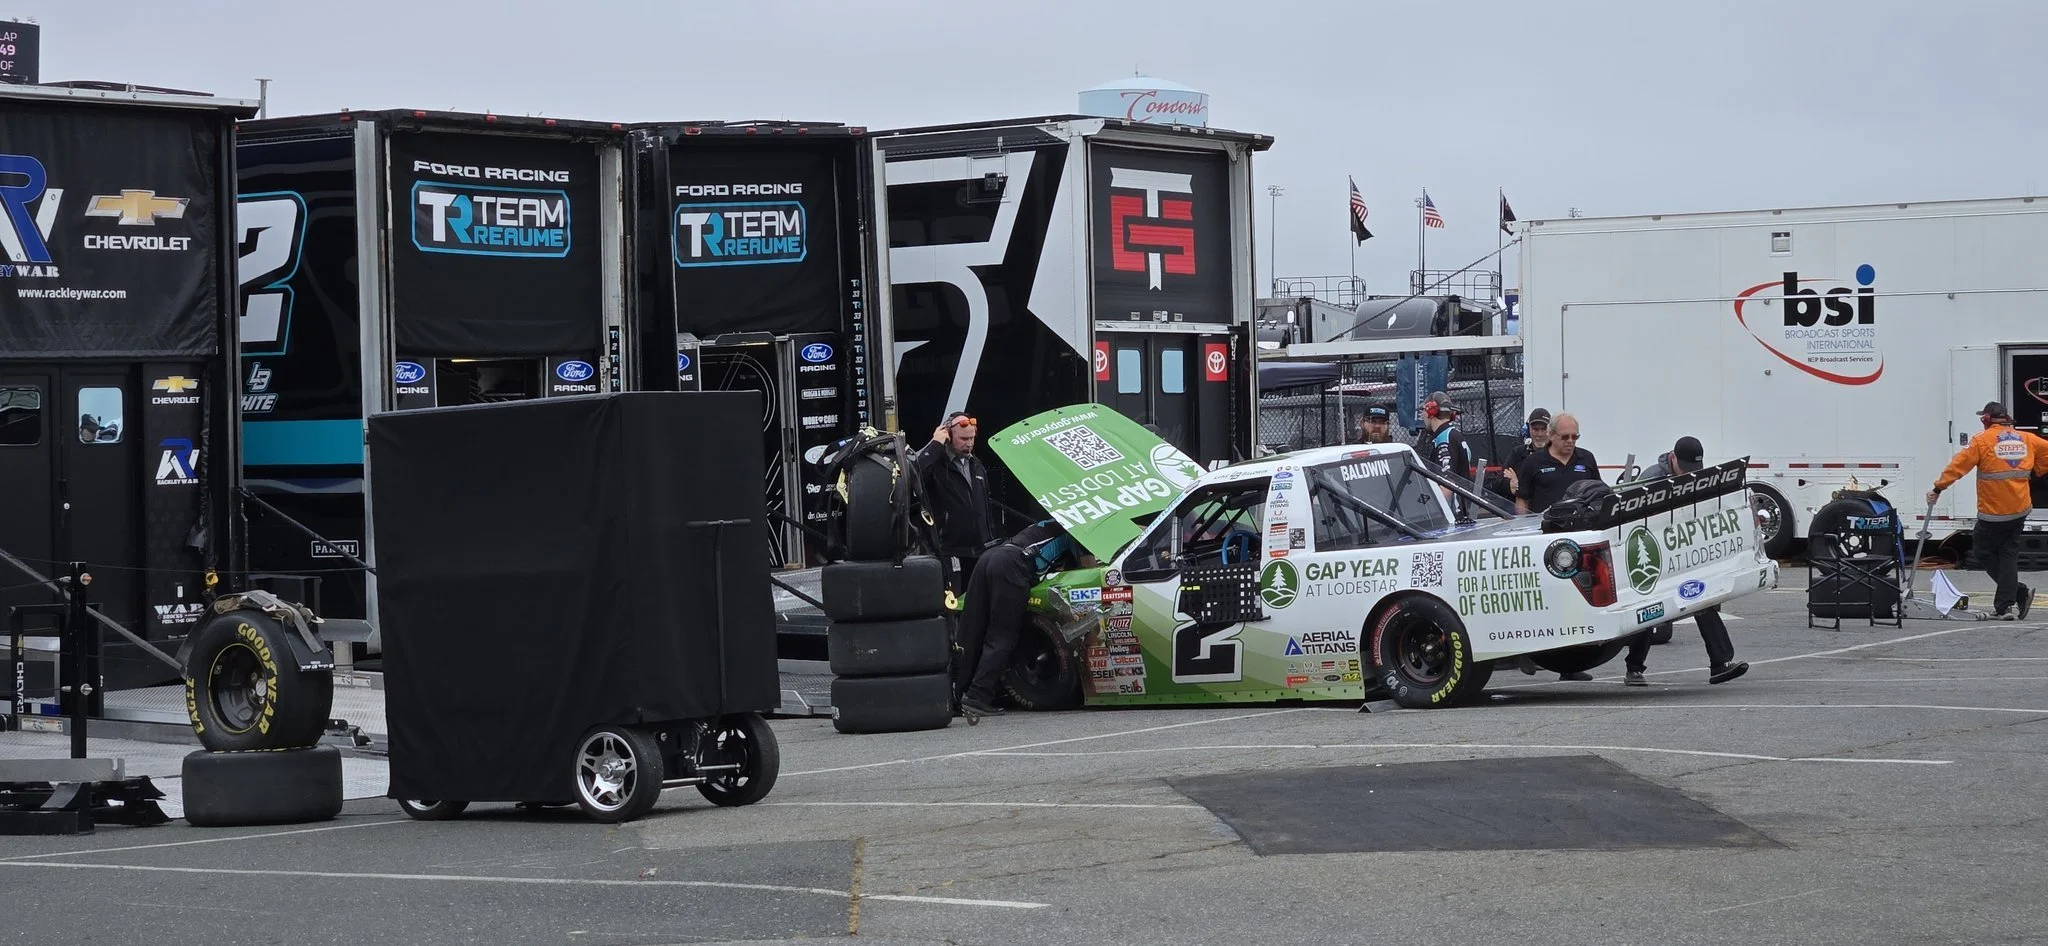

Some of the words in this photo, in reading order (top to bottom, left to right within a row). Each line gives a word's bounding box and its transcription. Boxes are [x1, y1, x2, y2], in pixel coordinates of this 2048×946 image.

[0, 60, 14, 70] OF
[1120, 90, 1207, 122] Concord
[413, 160, 480, 179] FORD
[485, 167, 570, 183] RACING
[676, 184, 729, 197] FORD
[733, 182, 803, 196] RACING
[473, 195, 564, 228] TEAM
[723, 210, 801, 237] TEAM
[84, 235, 191, 250] CHEVROLET
[473, 224, 565, 247] REAUME
[724, 236, 801, 256] REAUME
[17, 287, 127, 300] www.rackleywar.com
[1783, 264, 1875, 327] bsi
[1784, 329, 1839, 339] BROADCAST
[1842, 328, 1875, 338] SPORTS
[807, 346, 827, 360] Ford
[1806, 339, 1875, 350] INTERNATIONAL
[396, 364, 418, 380] Ford
[563, 363, 588, 380] Ford
[800, 363, 836, 373] RACING
[152, 396, 200, 404] CHEVROLET
[1417, 363, 1425, 421] MATERTENT
[241, 395, 276, 411] HITE
[1011, 412, 1098, 445] www.gapyear.life
[1122, 461, 1149, 479] AT
[1339, 459, 1391, 482] BALDWIN
[1116, 477, 1172, 507] GAP
[1611, 489, 1667, 516] FORD
[1668, 467, 1740, 499] RACING
[1663, 519, 1697, 551] GAP
[1695, 508, 1741, 541] YEAR
[1457, 550, 1487, 573] ONE
[1491, 545, 1536, 571] YEAR.
[1667, 553, 1681, 575] AT
[1686, 536, 1744, 569] LODESTAR
[1305, 559, 1351, 582] GAP
[1350, 557, 1399, 579] YEAR
[1758, 569, 1767, 588] 2
[1305, 583, 1325, 598] AT
[1327, 579, 1398, 597] LODESTAR
[1457, 575, 1479, 594] FOR
[1481, 575, 1488, 592] A
[1491, 571, 1541, 592] LIFETIME
[1682, 581, 1703, 597] Ford
[1070, 588, 1100, 601] SKF
[1102, 592, 1132, 600] CRAFTSMAN
[1459, 595, 1479, 617] OF
[1481, 589, 1549, 616] GROWTH.
[1646, 603, 1664, 614] TEAM
[1108, 619, 1130, 629] KLOTZ
[1489, 627, 1555, 641] GUARDIAN
[1560, 625, 1595, 637] LIFTS
[1301, 630, 1355, 643] AERIAL
[1109, 645, 1130, 654] Holley
[1301, 642, 1357, 655] TITANS
[1114, 656, 1141, 664] tilton
[1430, 631, 1463, 703] GOODYEAR
[236, 622, 279, 735] GOODYEAR
[1120, 680, 1143, 693] Stilo
[186, 676, 206, 735] EAGLE
